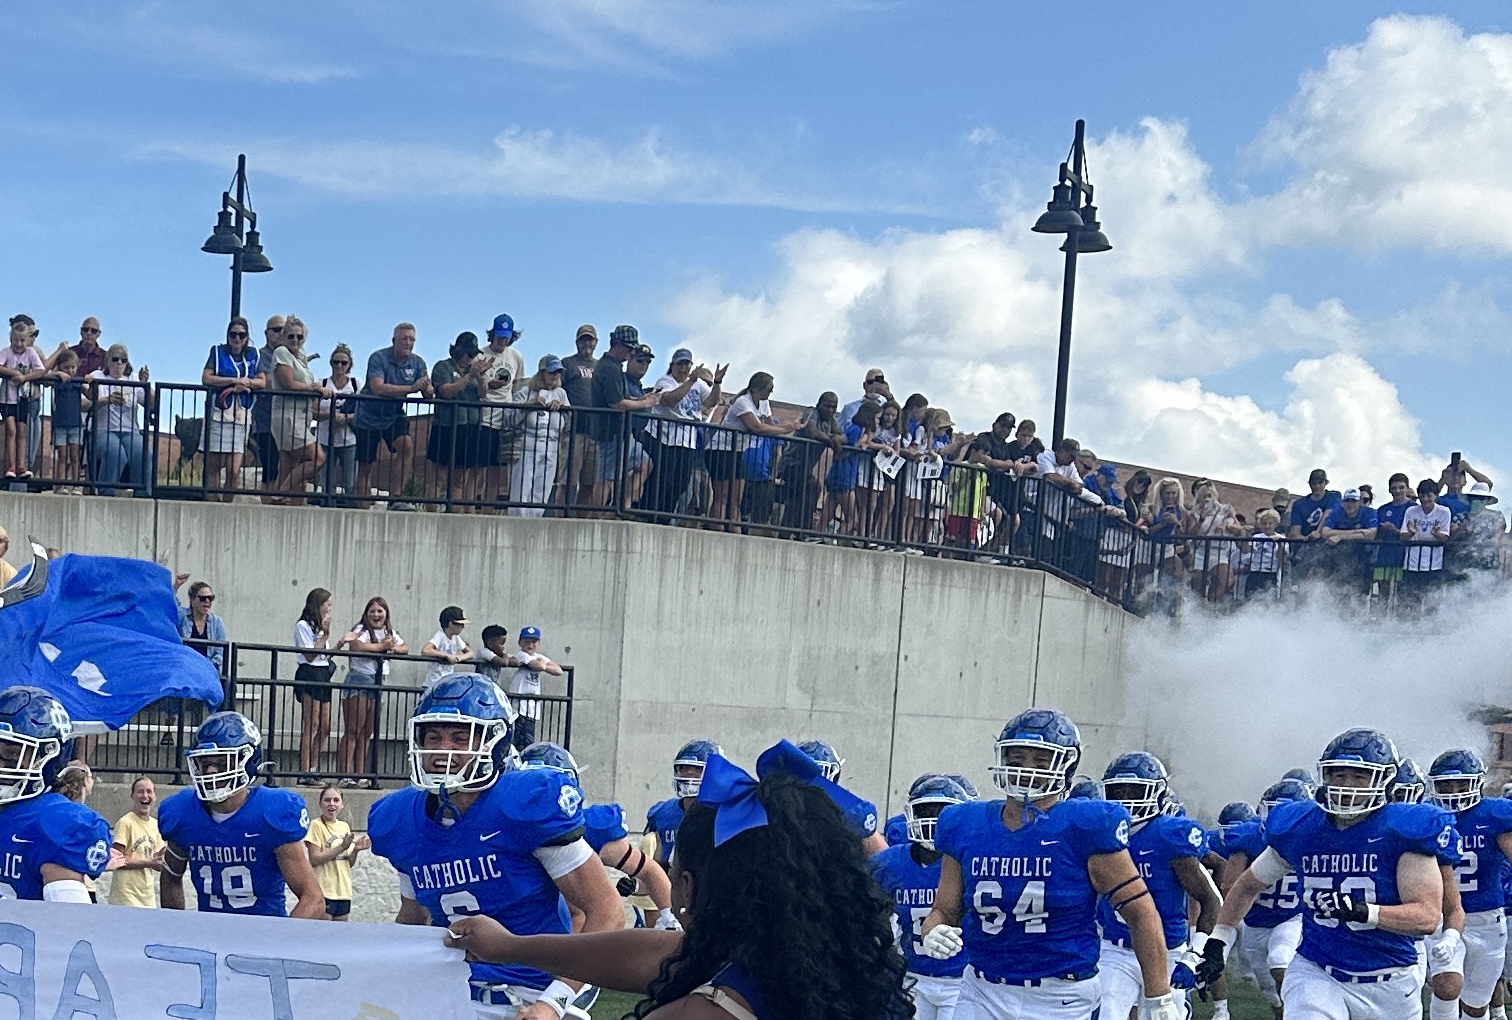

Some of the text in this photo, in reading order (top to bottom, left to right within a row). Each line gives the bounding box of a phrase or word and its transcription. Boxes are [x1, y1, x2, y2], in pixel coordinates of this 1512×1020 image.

[189, 845, 257, 863] CATHOLIC
[1301, 853, 1378, 873] CATHOLIC
[412, 854, 502, 889] CATHOLIC
[971, 857, 1052, 877] CATHOLIC
[973, 880, 1049, 935] 64
